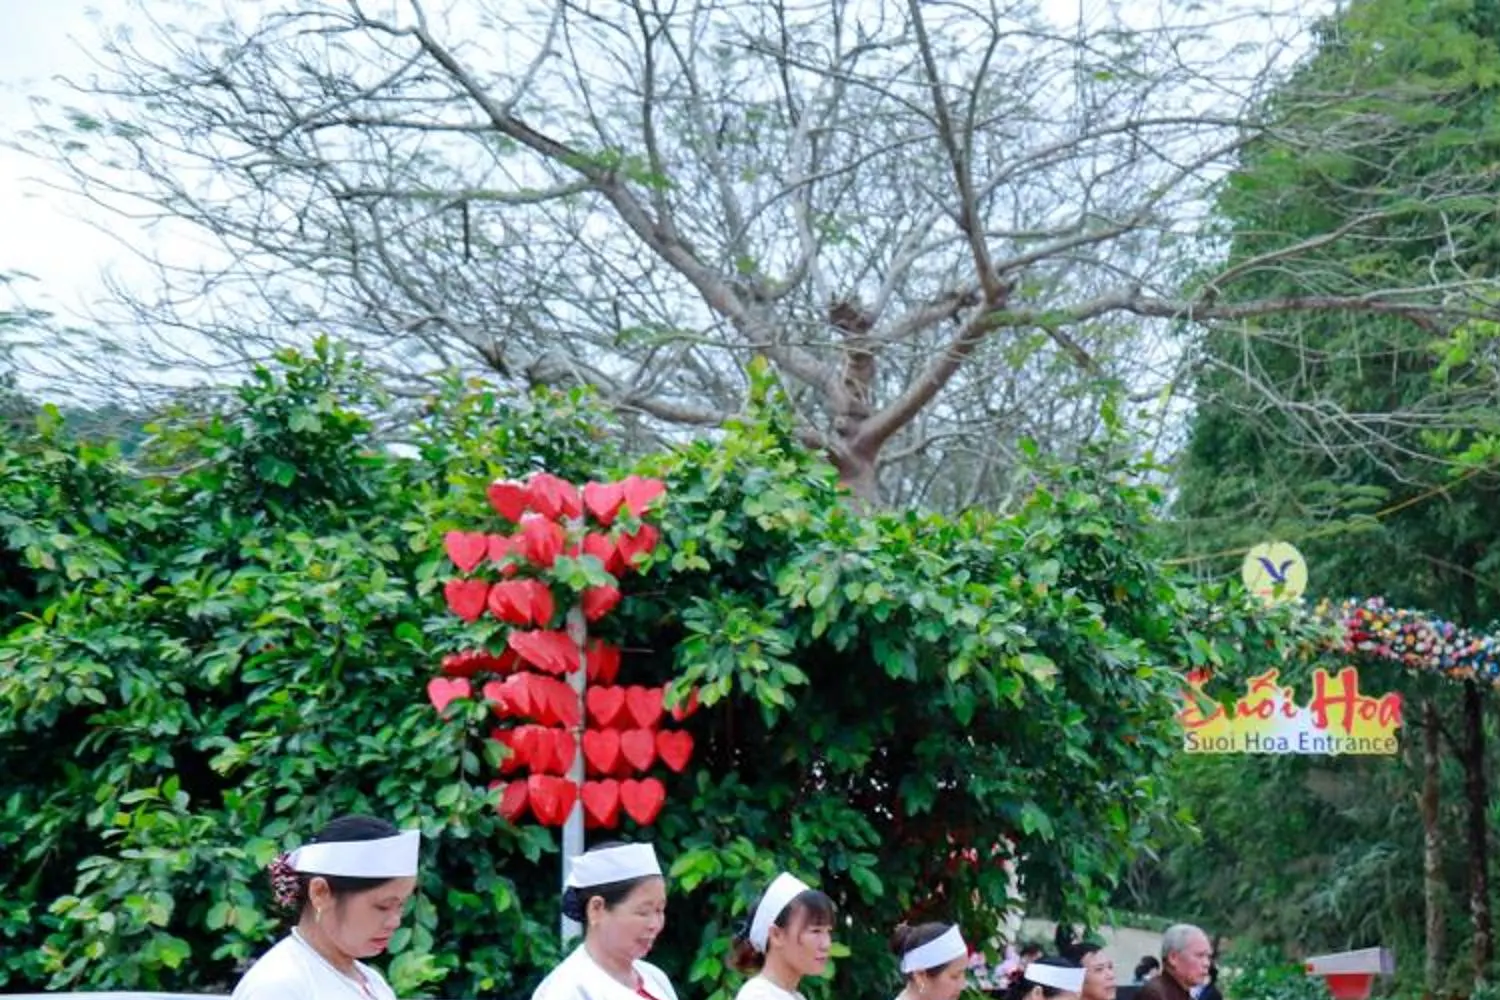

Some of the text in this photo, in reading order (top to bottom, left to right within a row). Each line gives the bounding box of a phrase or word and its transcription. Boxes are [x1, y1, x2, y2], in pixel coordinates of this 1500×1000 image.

[1311, 667, 1404, 733] Hoa
[1186, 731, 1396, 751] Suoi Hoa Entrance
